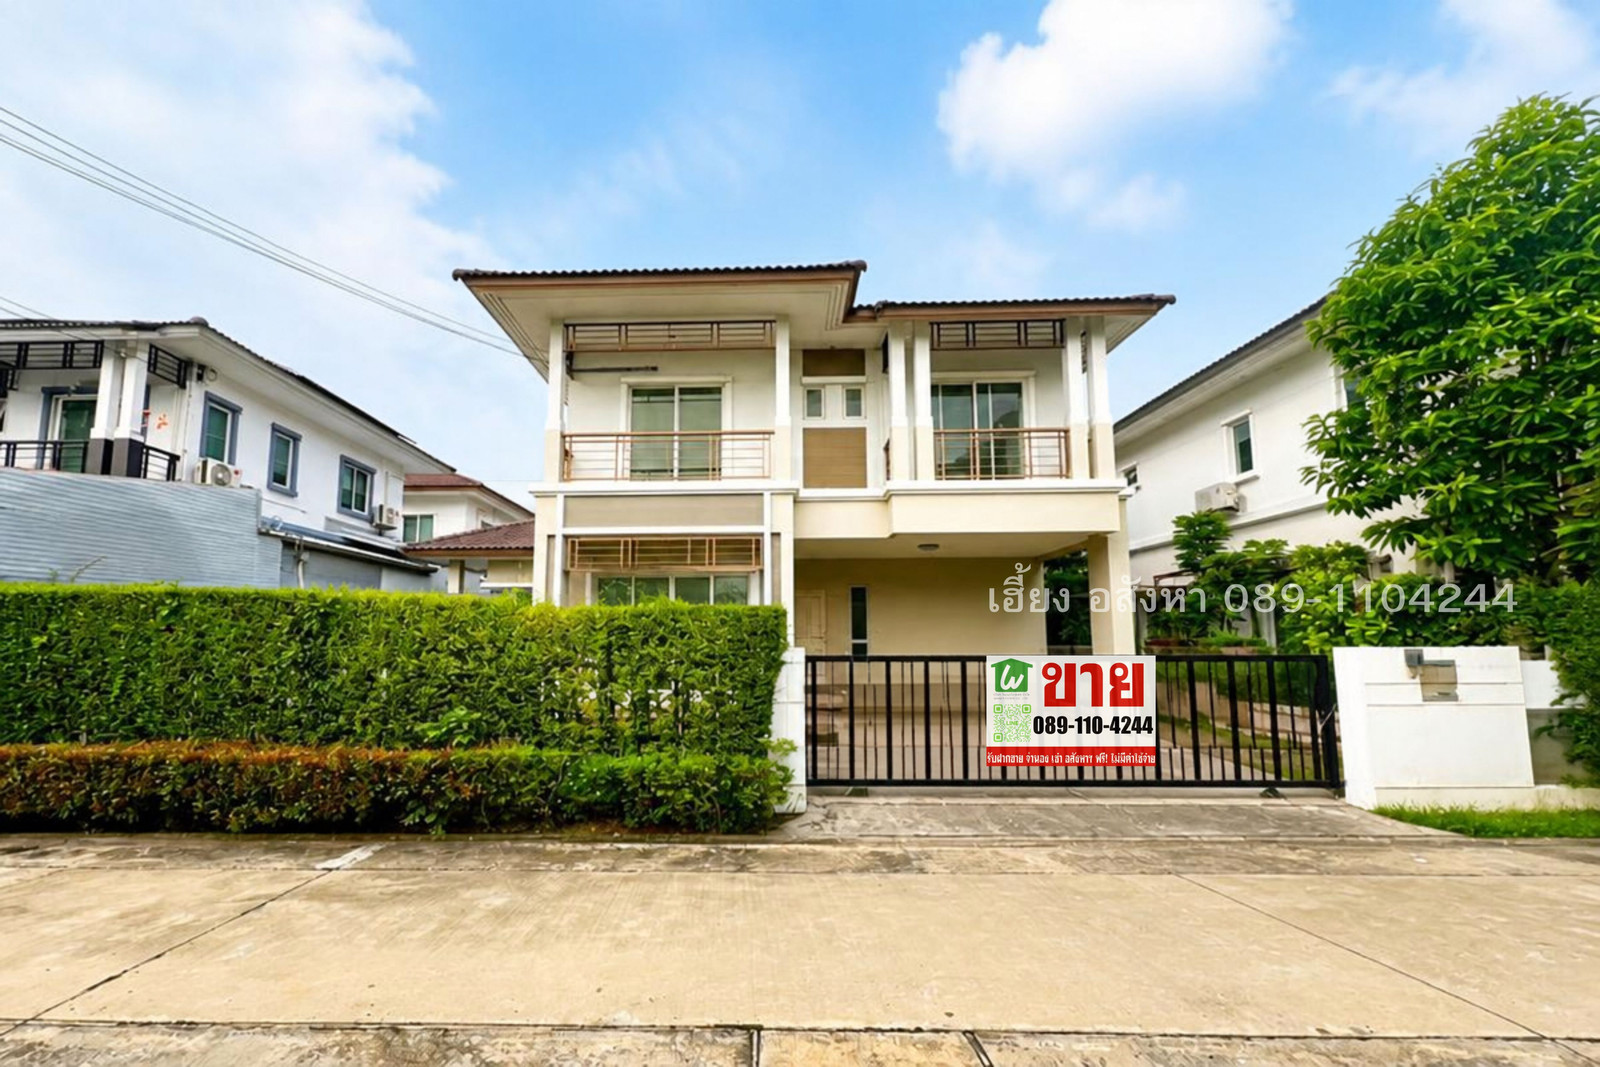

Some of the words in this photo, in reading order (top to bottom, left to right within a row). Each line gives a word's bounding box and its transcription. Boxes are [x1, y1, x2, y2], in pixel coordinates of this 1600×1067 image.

[1041, 662, 1145, 707] ขาย
[1033, 715, 1153, 735] 089-110-4244
[987, 751, 1024, 764] รับฝากขาย
[1025, 751, 1049, 764] จำนอง
[1051, 752, 1063, 764] เช่า
[1095, 752, 1108, 764] ฟรี!
[1110, 751, 1156, 764] ไม่มีค่าใช้จ่าย
